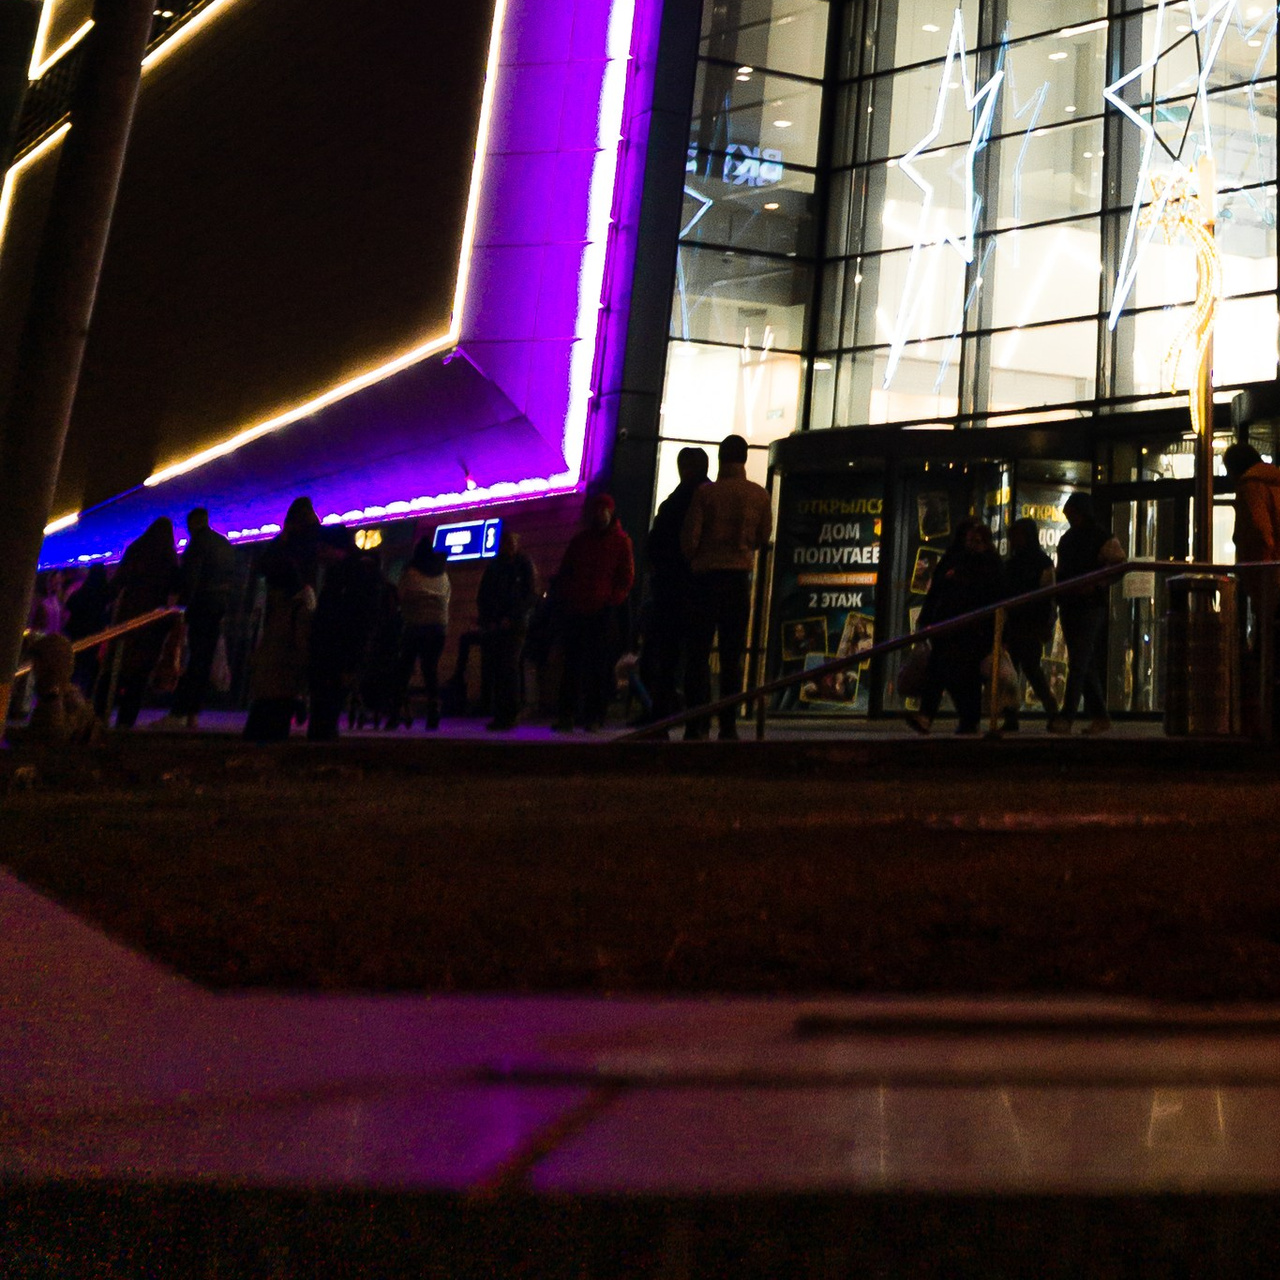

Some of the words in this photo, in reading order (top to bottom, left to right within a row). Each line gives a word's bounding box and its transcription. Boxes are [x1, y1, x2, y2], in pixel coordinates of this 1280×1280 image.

[818, 523, 861, 544] ДОМ
[808, 592, 818, 608] 2
[821, 592, 863, 608] ЭТАЖ
